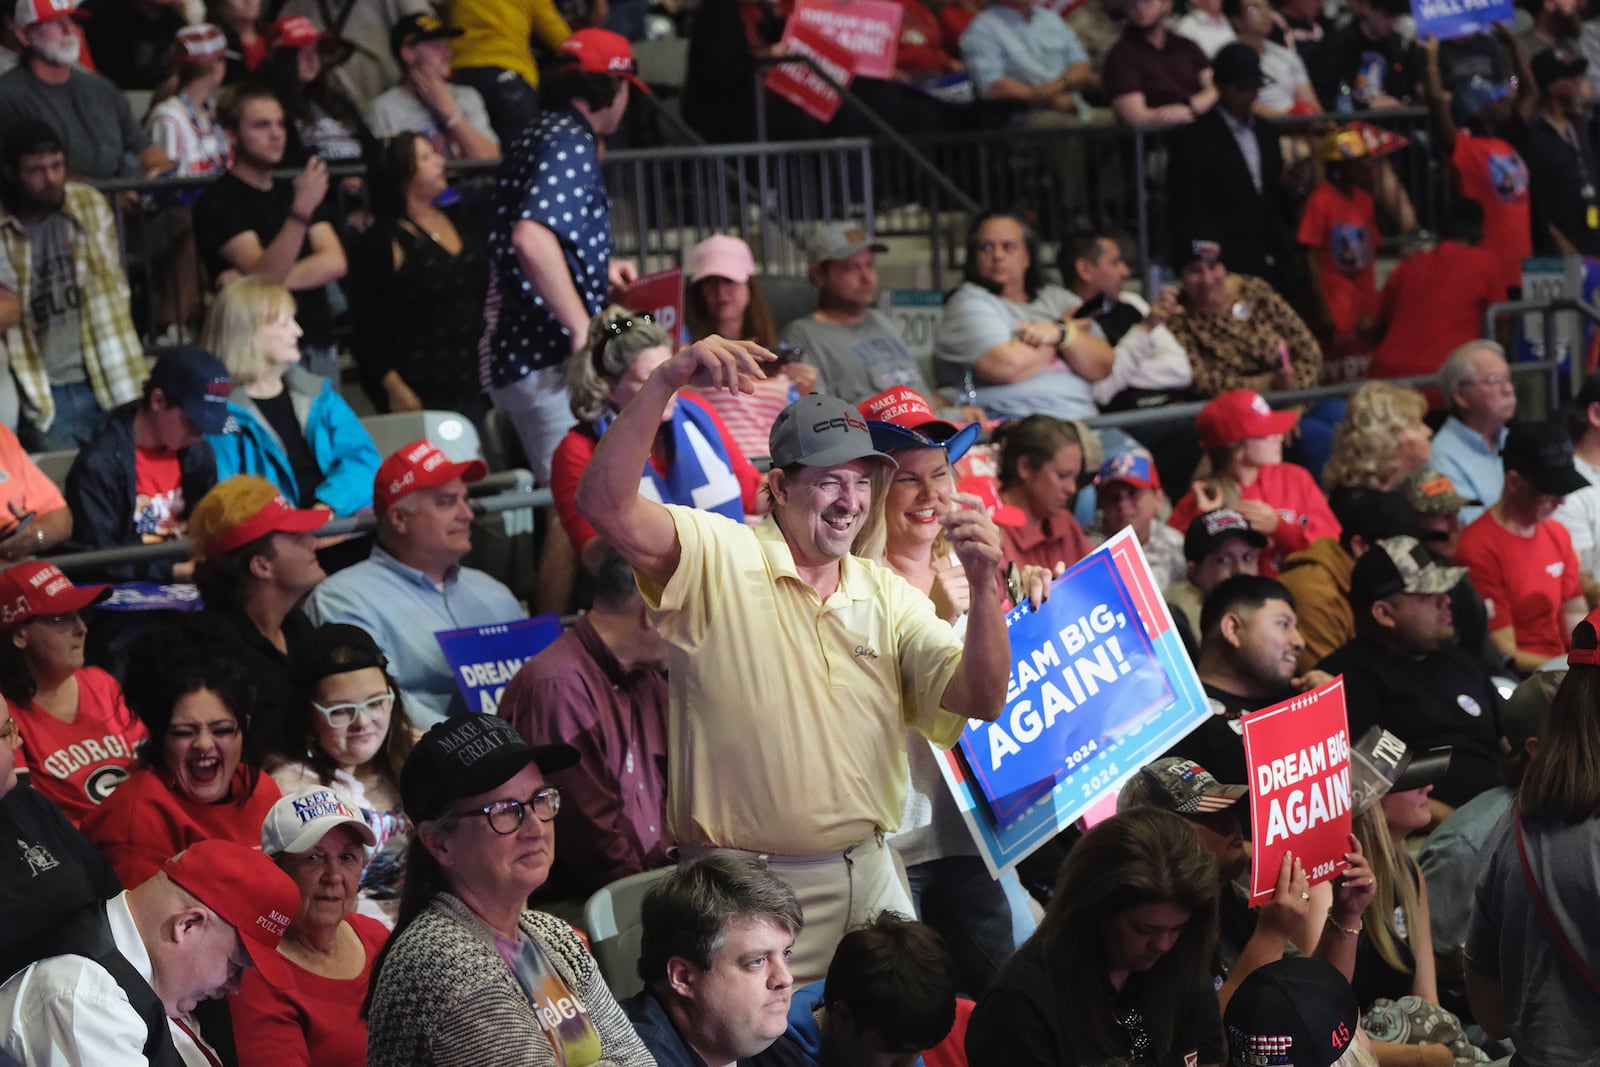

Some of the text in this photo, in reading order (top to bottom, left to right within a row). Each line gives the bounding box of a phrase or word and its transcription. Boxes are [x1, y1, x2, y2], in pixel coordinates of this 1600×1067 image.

[870, 393, 897, 414] MAKE
[881, 402, 909, 422] GREAT
[1059, 603, 1127, 656] BIG,
[988, 635, 1131, 772] AGAIN!
[438, 721, 481, 754] MAKE
[457, 730, 504, 767] GREAT
[1064, 739, 1098, 769] 2024
[1257, 741, 1326, 796] DREAM
[1080, 765, 1119, 798] 2024
[292, 790, 329, 813] KEEP
[1312, 859, 1335, 880] 2024
[1331, 1021, 1350, 1049] 45
